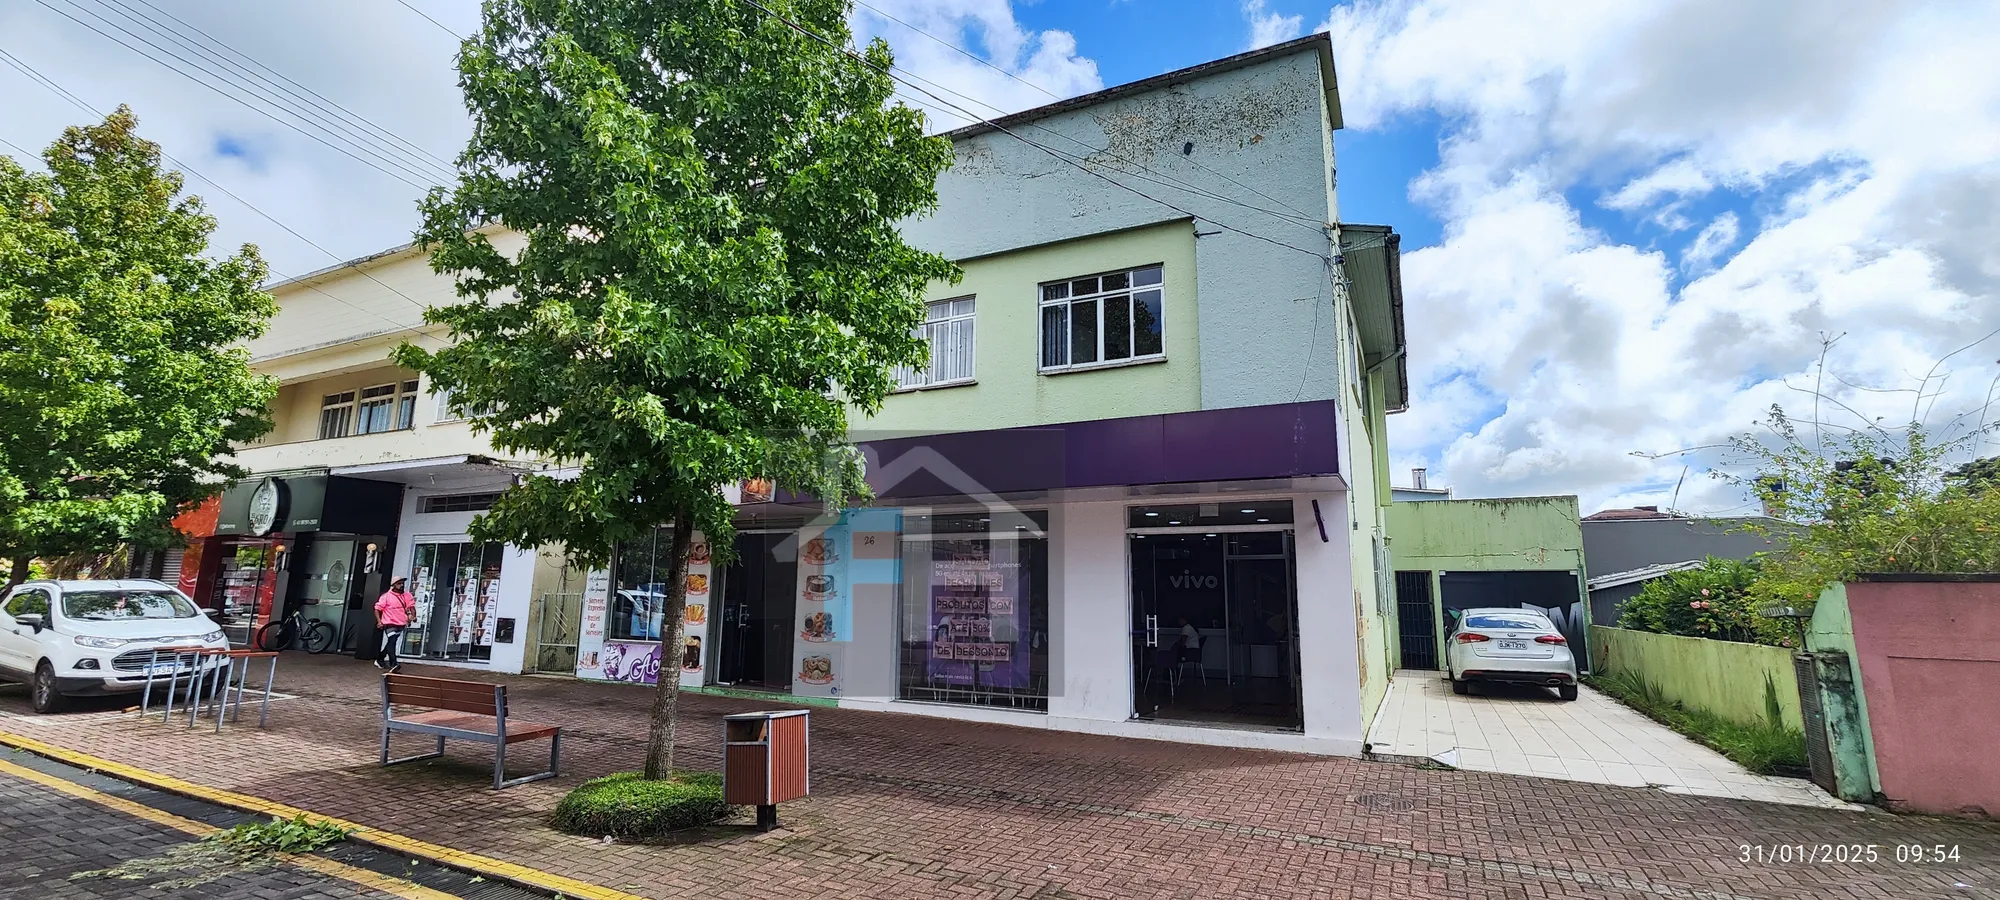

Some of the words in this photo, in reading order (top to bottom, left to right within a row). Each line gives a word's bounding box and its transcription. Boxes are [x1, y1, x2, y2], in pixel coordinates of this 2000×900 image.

[864, 535, 875, 546] 26
[954, 555, 990, 567] SALDÃO
[946, 579, 976, 588] FECHA
[1169, 569, 1218, 589] vivo
[936, 599, 985, 610] PRODUTOS
[990, 600, 1011, 610] COM
[973, 623, 991, 633] 50%
[937, 646, 951, 655] DE
[956, 647, 1008, 657] DESCONTO
